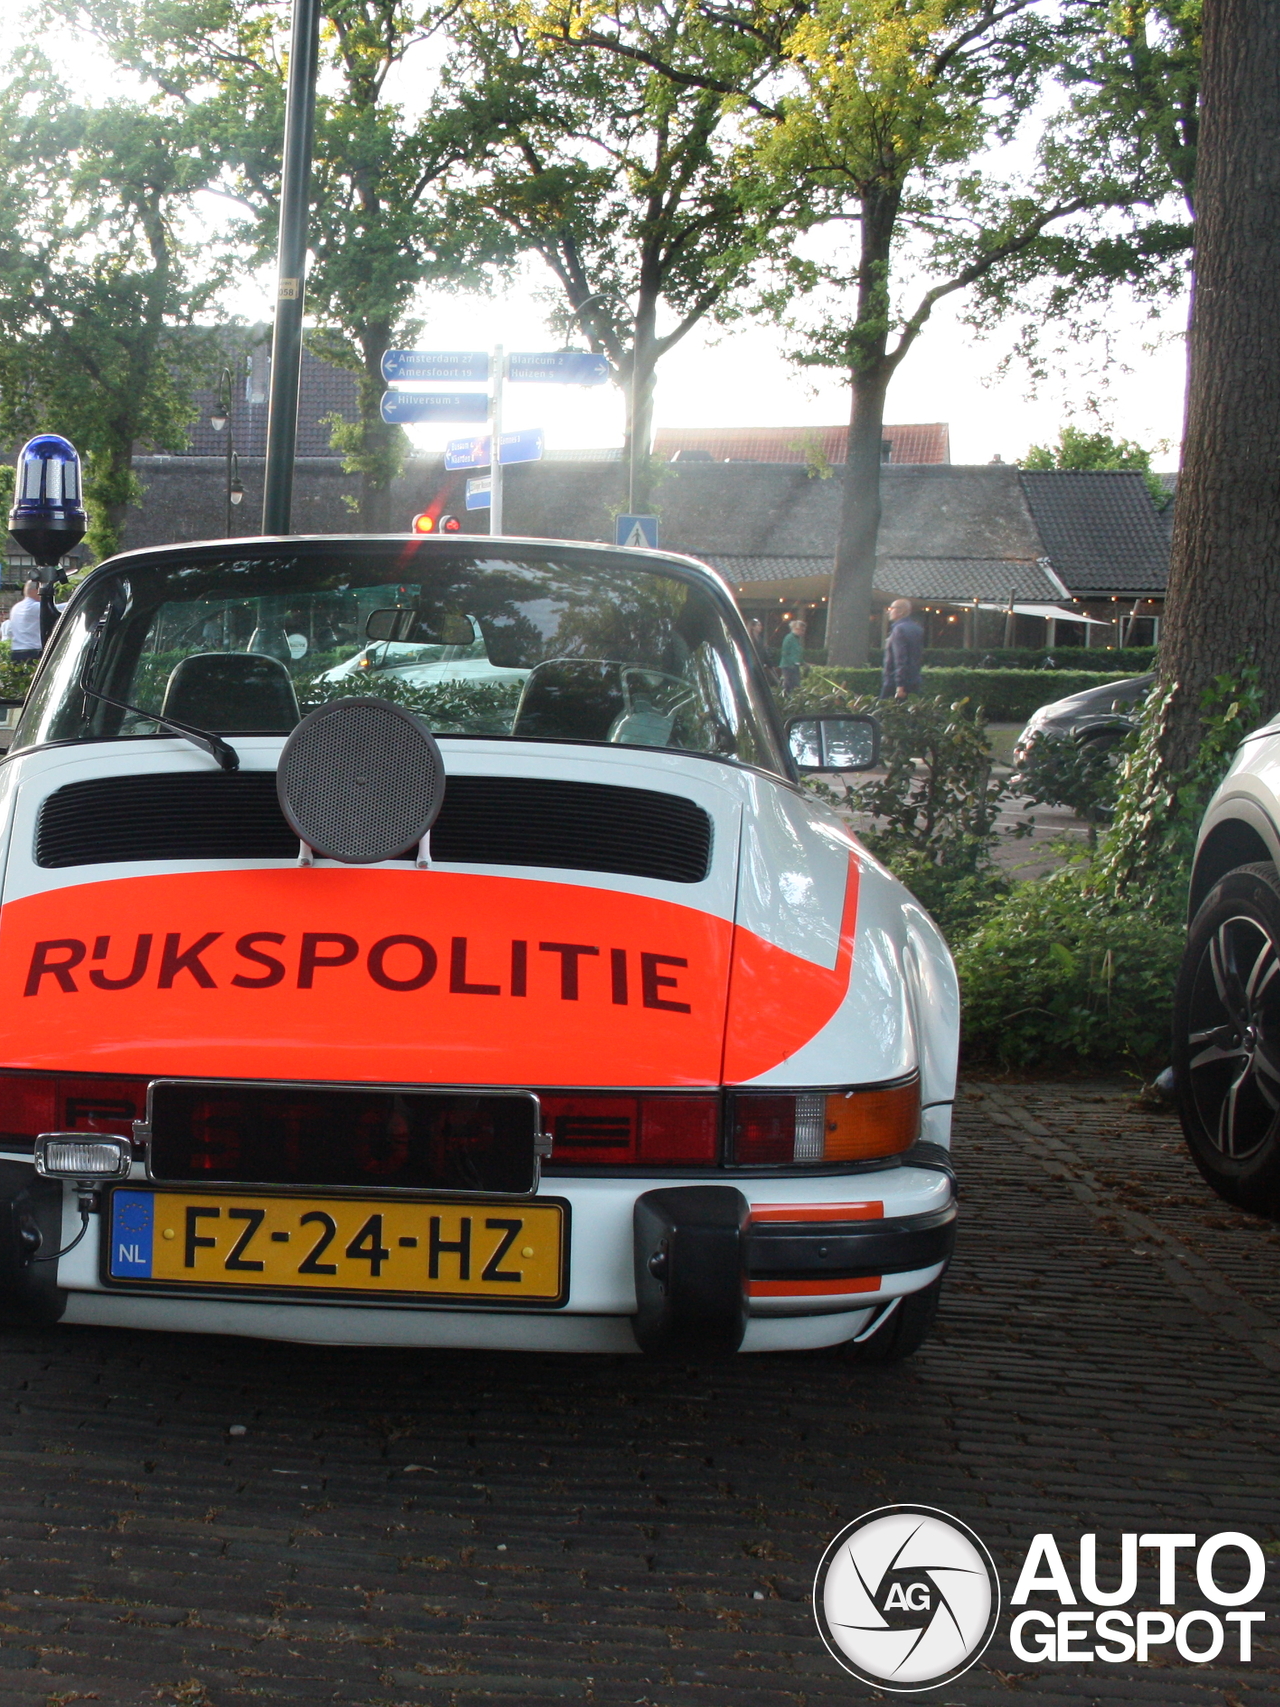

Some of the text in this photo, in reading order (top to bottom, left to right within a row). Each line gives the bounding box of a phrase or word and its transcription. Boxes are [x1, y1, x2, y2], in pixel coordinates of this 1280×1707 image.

[398, 354, 473, 364] Amsterdam 27
[511, 355, 564, 365] Blaricum 2
[398, 368, 472, 377] Amersfoort 19
[511, 368, 554, 379] Huizen 5
[398, 395, 460, 405] Hilversum 5
[451, 441, 469, 452] Bussum
[451, 454, 471, 464] Naarden
[24, 931, 691, 1014] RIJKSPOLITIE
[185, 1206, 523, 1283] FZ-24-HZ
[119, 1243, 146, 1264] NL
